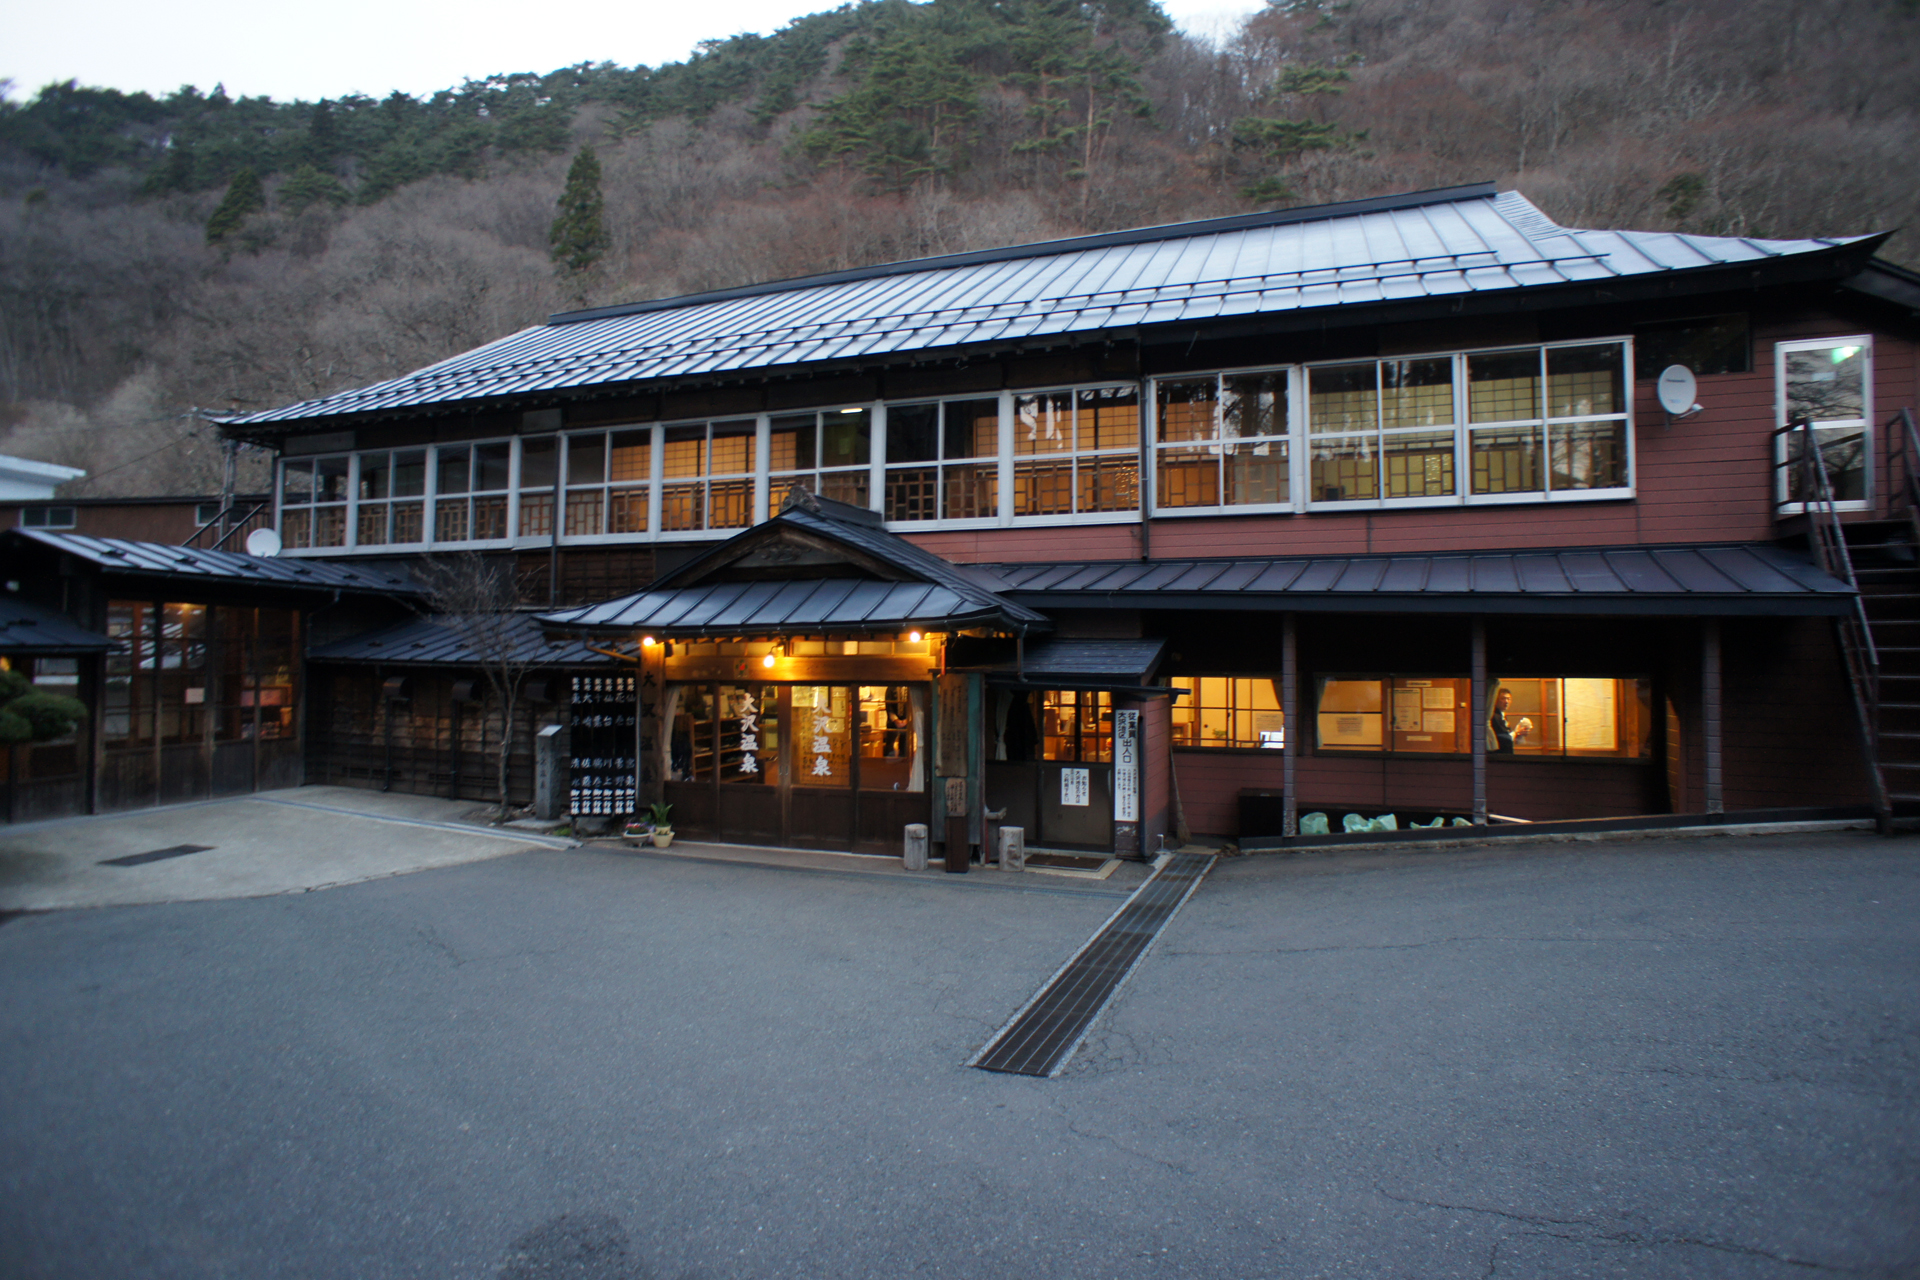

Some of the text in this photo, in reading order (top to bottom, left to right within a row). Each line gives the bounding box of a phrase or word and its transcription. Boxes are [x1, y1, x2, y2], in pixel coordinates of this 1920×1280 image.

[739, 692, 760, 773] 大沢温泉
[811, 693, 833, 776] 大沢温泉
[1122, 739, 1132, 763] 出入口
